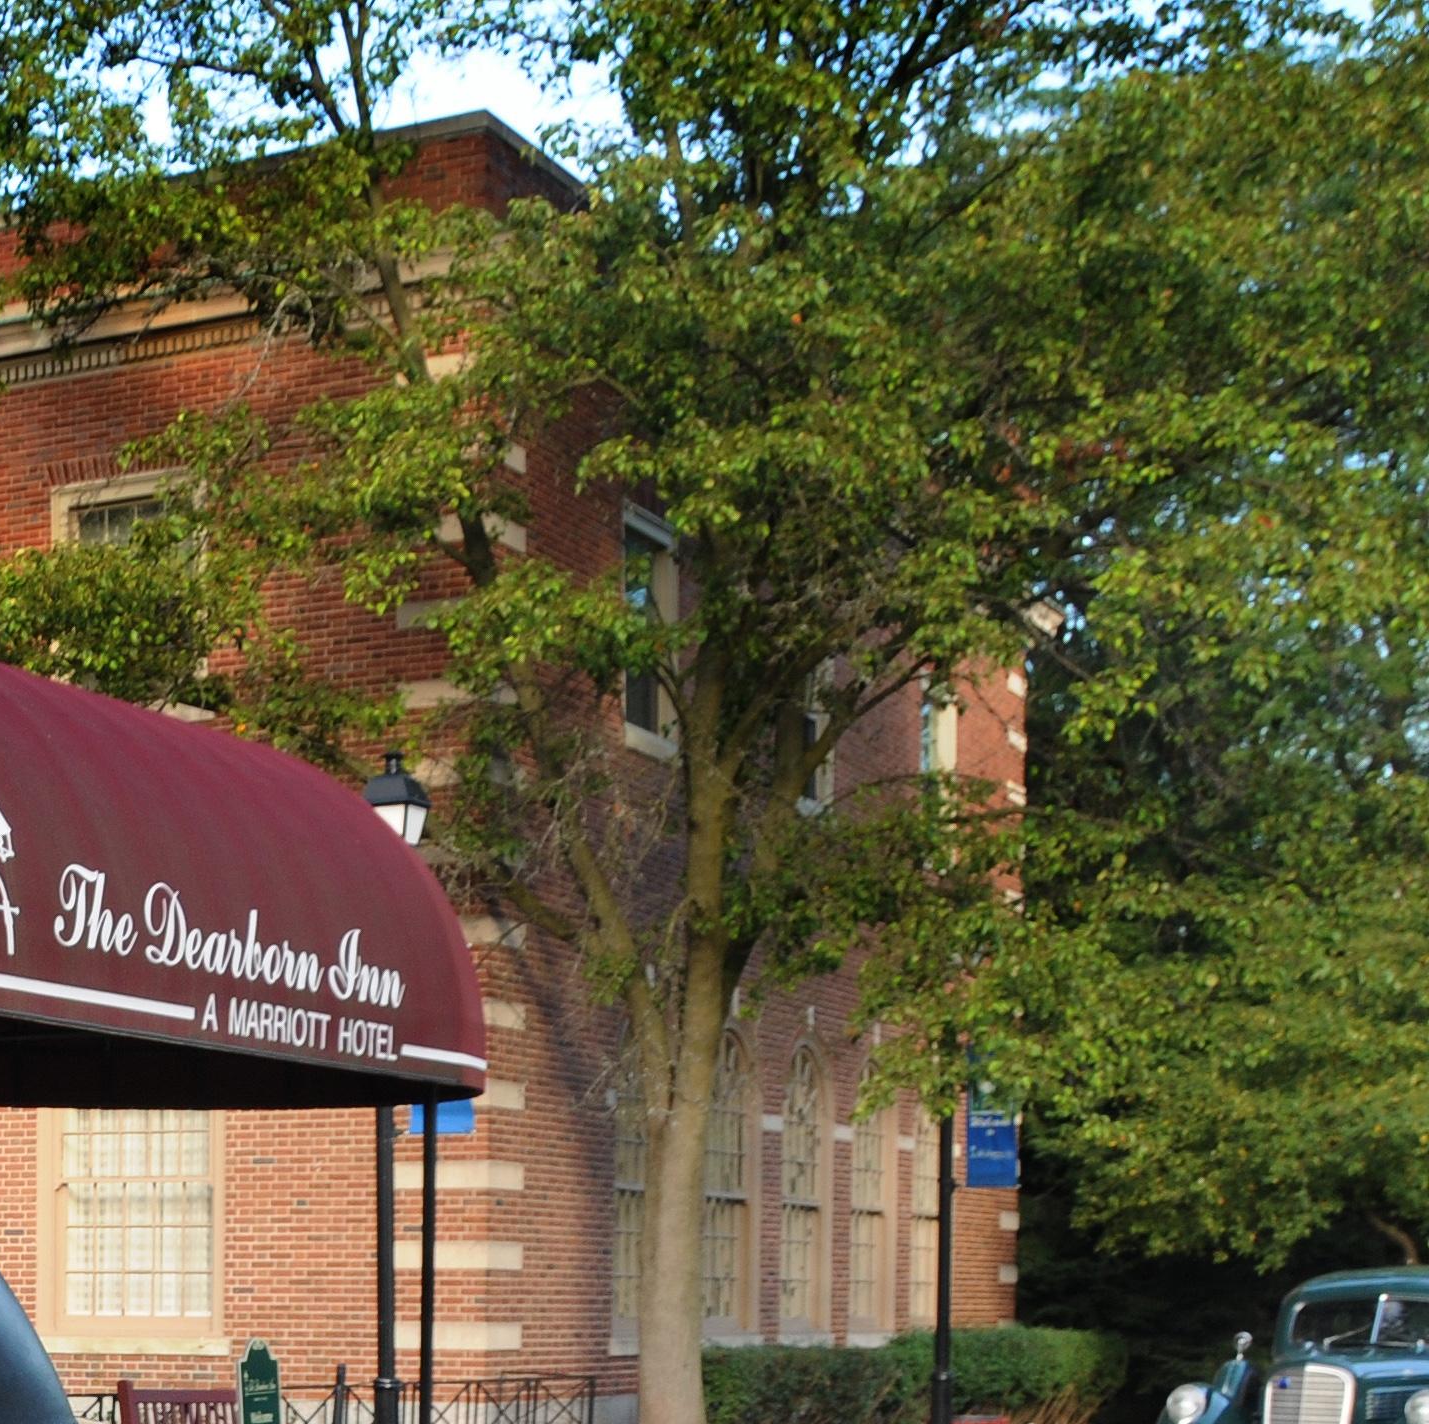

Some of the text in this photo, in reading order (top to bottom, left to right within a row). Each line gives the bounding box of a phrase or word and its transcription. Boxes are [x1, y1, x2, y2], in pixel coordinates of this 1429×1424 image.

[53, 863, 405, 1009] The Dearborn Inn
[201, 993, 398, 1061] A MARRIOTT HOTEL
